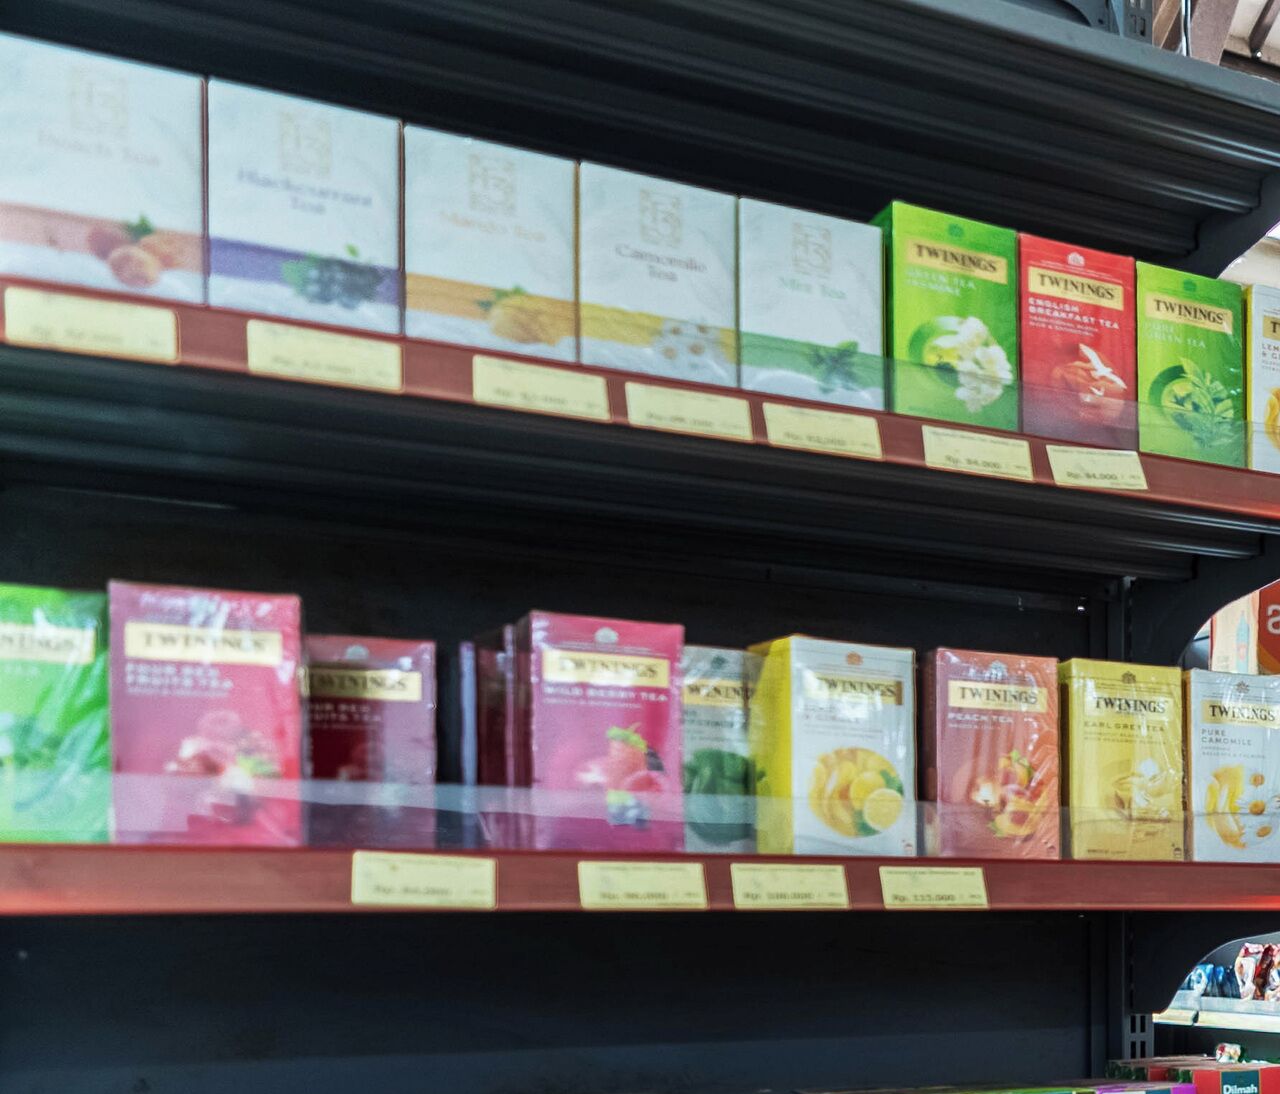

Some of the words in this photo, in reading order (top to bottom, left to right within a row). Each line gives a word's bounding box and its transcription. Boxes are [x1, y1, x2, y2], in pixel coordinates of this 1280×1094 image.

[914, 243, 998, 274] TWININGS
[1037, 272, 1116, 301] TWININGS
[1028, 297, 1080, 313] ENGLISH
[1153, 300, 1226, 325] TWININGS
[1028, 306, 1096, 325] BREAKFAST
[1099, 319, 1120, 331] TEA
[142, 631, 267, 652] TWININGS
[310, 674, 409, 693] WININGS
[959, 687, 1037, 705] TWININGS
[1094, 695, 1168, 714] TWININGS
[1209, 705, 1276, 722] TWININGS
[1083, 721, 1113, 731] EARL
[1201, 728, 1227, 738] PURE
[1201, 736, 1253, 746] CAMOMILE
